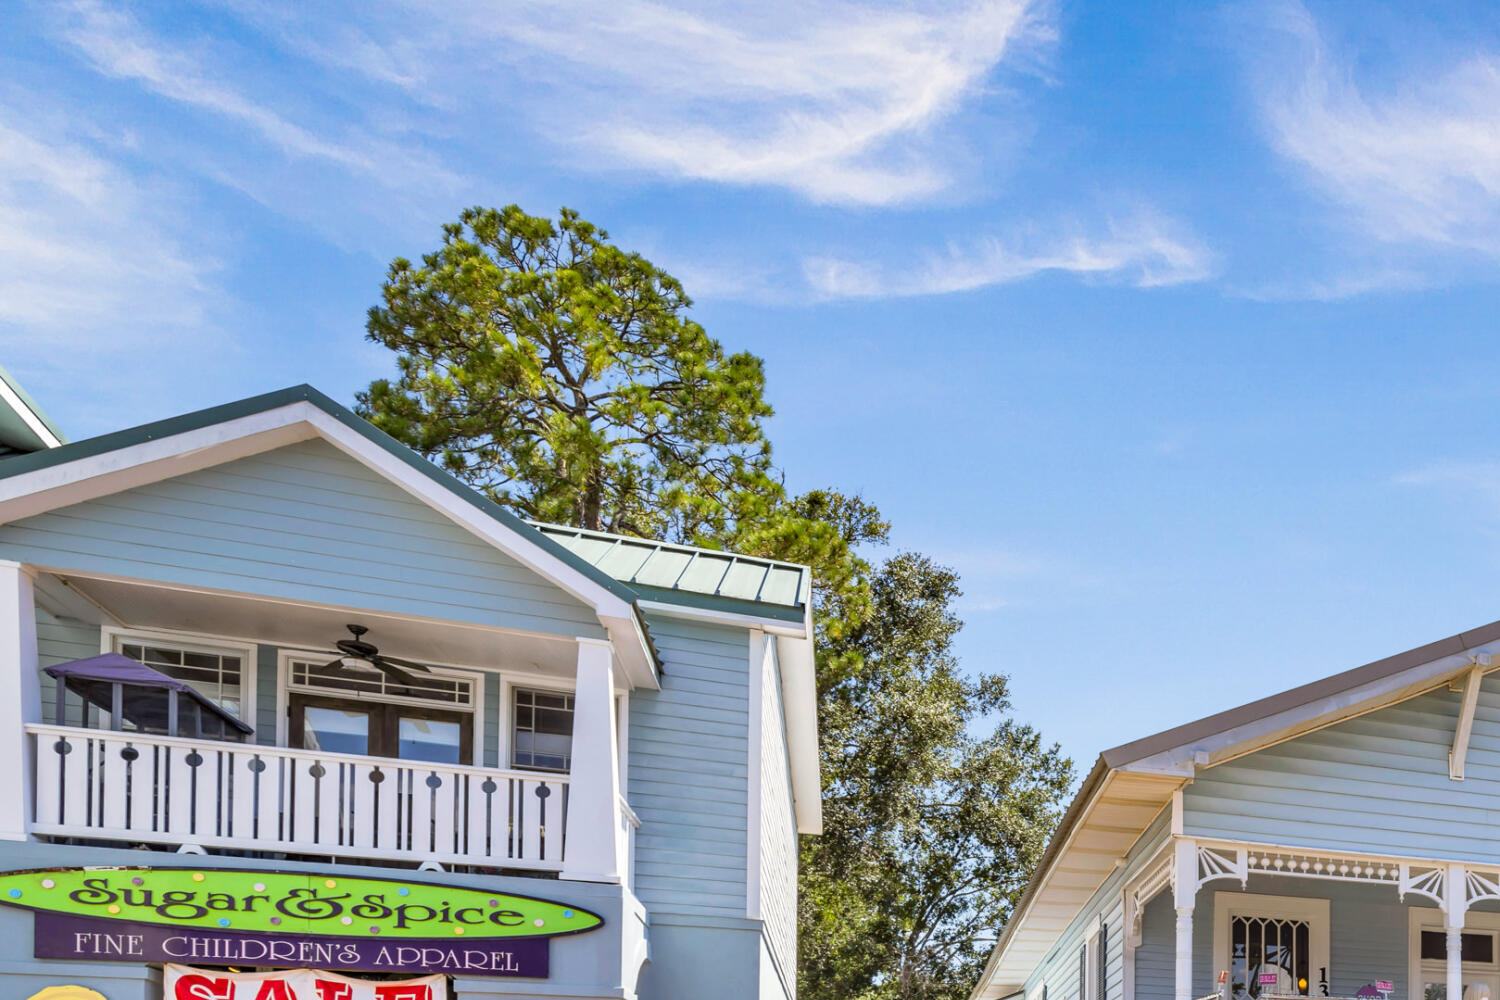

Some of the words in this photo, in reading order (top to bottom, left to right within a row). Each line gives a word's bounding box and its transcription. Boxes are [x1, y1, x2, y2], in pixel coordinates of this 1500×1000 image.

[69, 878, 270, 920] Sugar
[275, 888, 352, 920] &
[351, 894, 525, 929] Spice
[74, 932, 144, 956] FINE
[161, 936, 361, 964] CHILDREN'S
[373, 946, 519, 972] APPAREL
